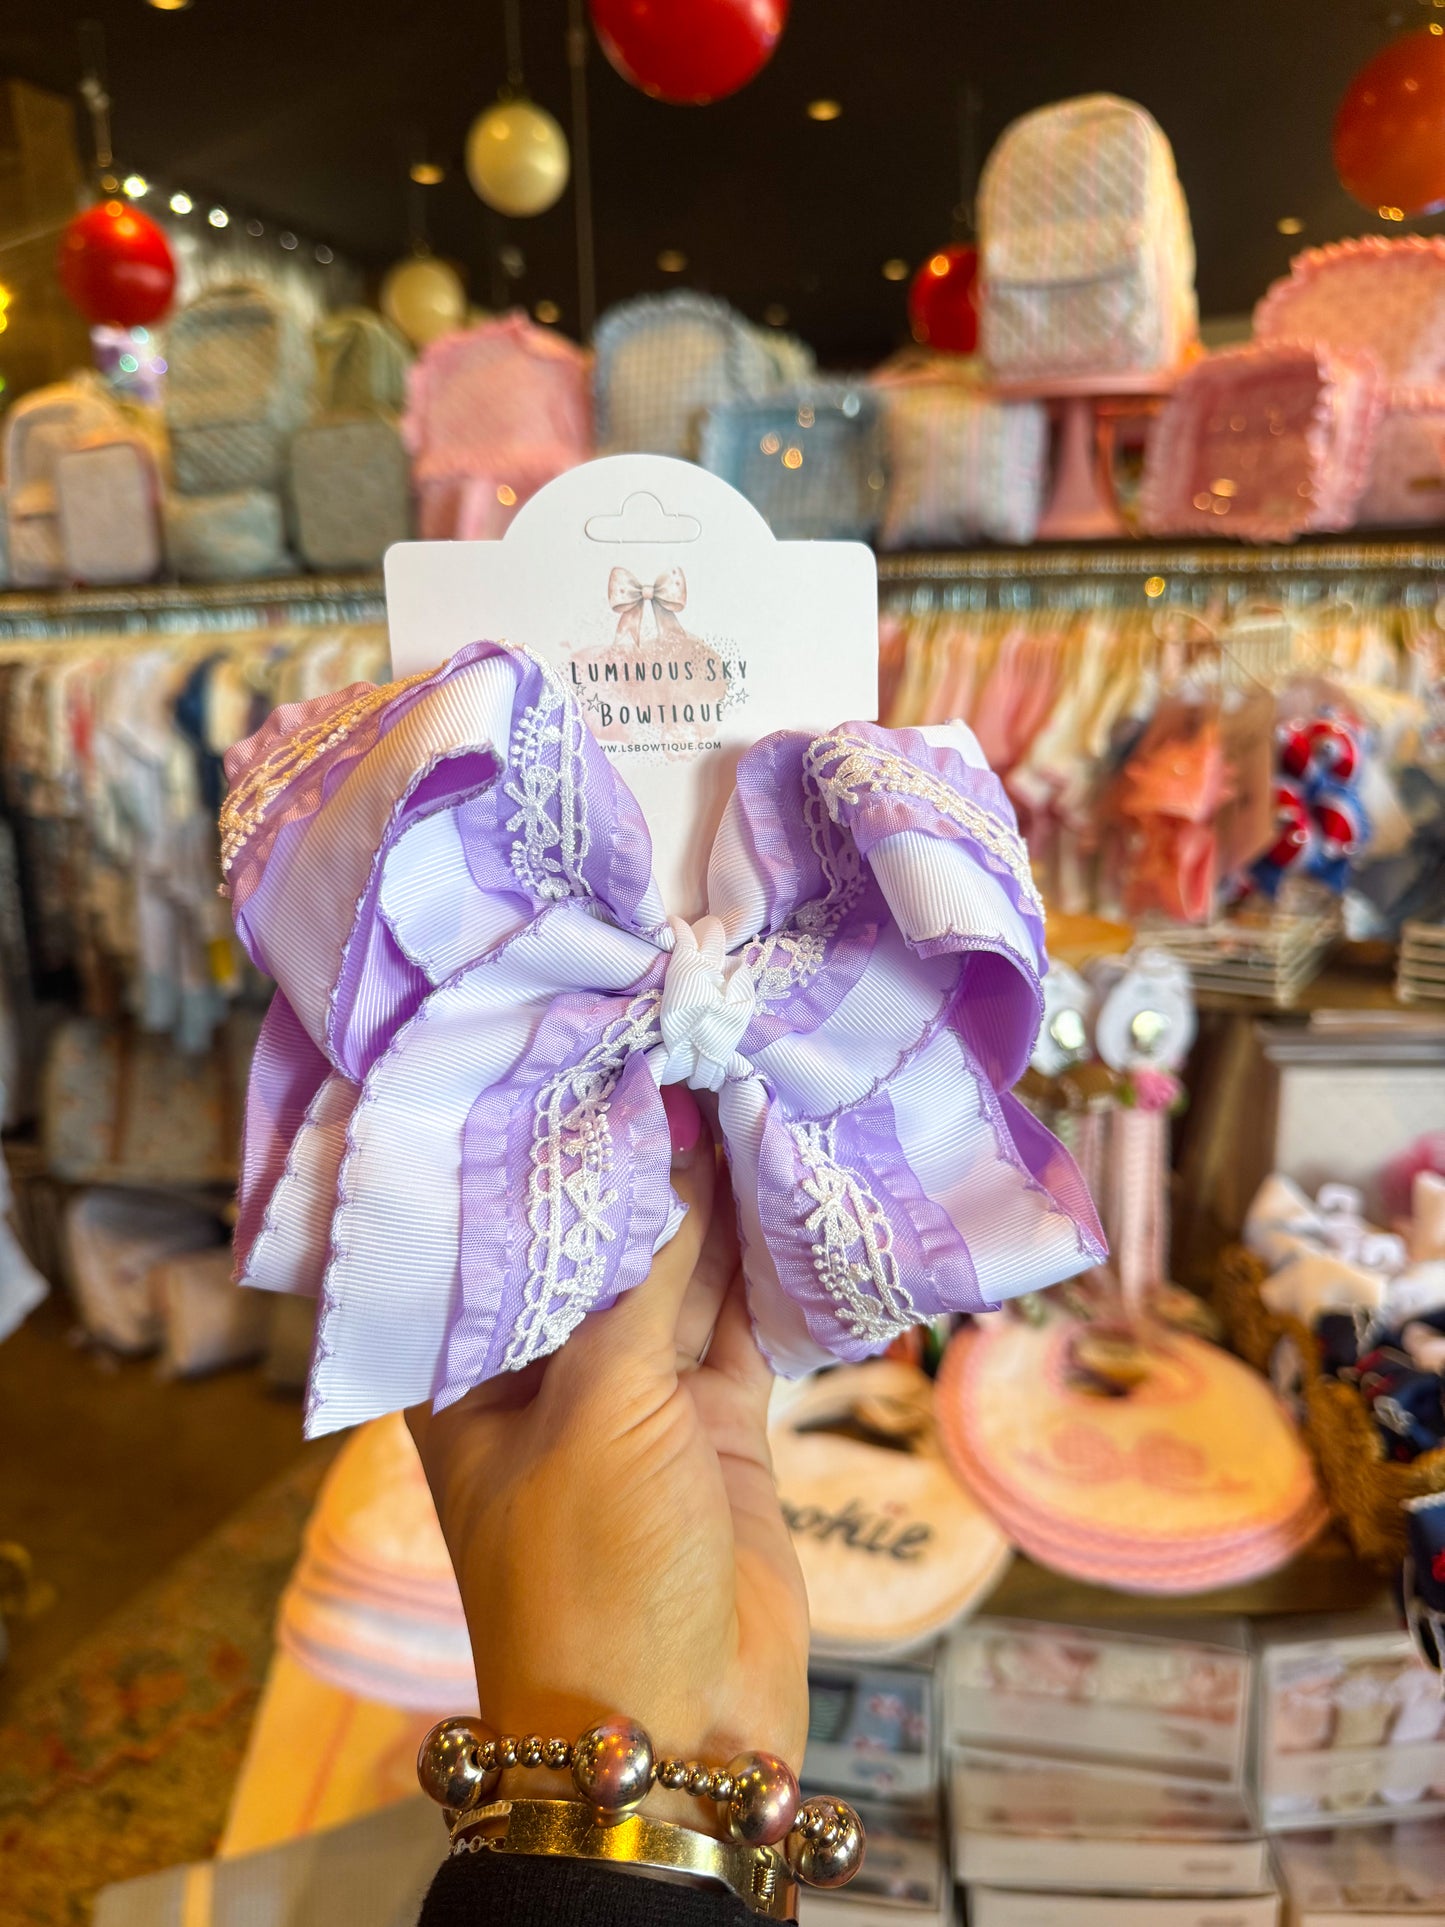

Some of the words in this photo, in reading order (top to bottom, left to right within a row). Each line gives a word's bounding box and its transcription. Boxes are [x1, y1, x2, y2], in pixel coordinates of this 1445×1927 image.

[571, 660, 693, 685] LUMINOUS
[706, 658, 747, 682] SKY
[601, 702, 723, 727] BOWTIQUE
